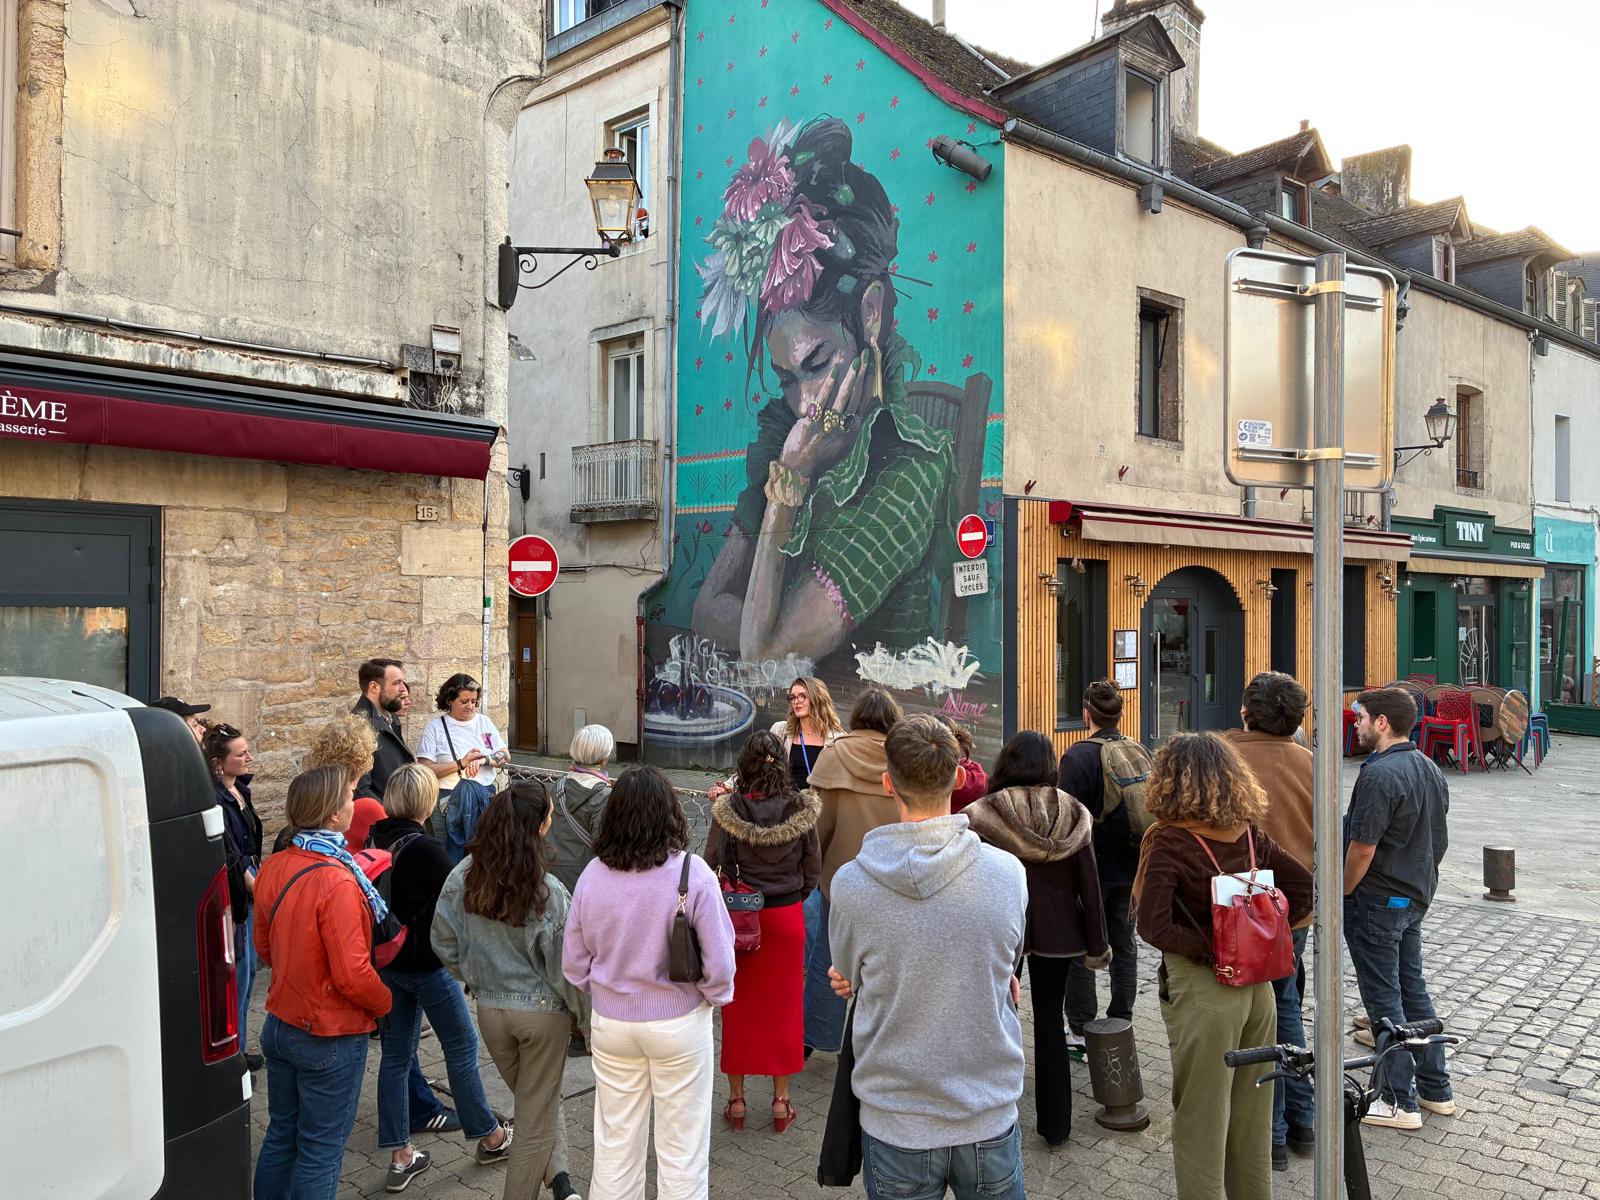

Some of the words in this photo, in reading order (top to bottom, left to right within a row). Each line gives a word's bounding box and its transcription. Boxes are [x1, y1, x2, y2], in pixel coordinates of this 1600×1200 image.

[0, 390, 68, 423] ÈME
[421, 507, 433, 519] 15
[1456, 520, 1485, 543] TINY
[1521, 542, 1531, 550] FOOD
[955, 562, 986, 573] INTERDIT
[963, 573, 980, 582] SAUF
[960, 582, 984, 593] CYCLES
